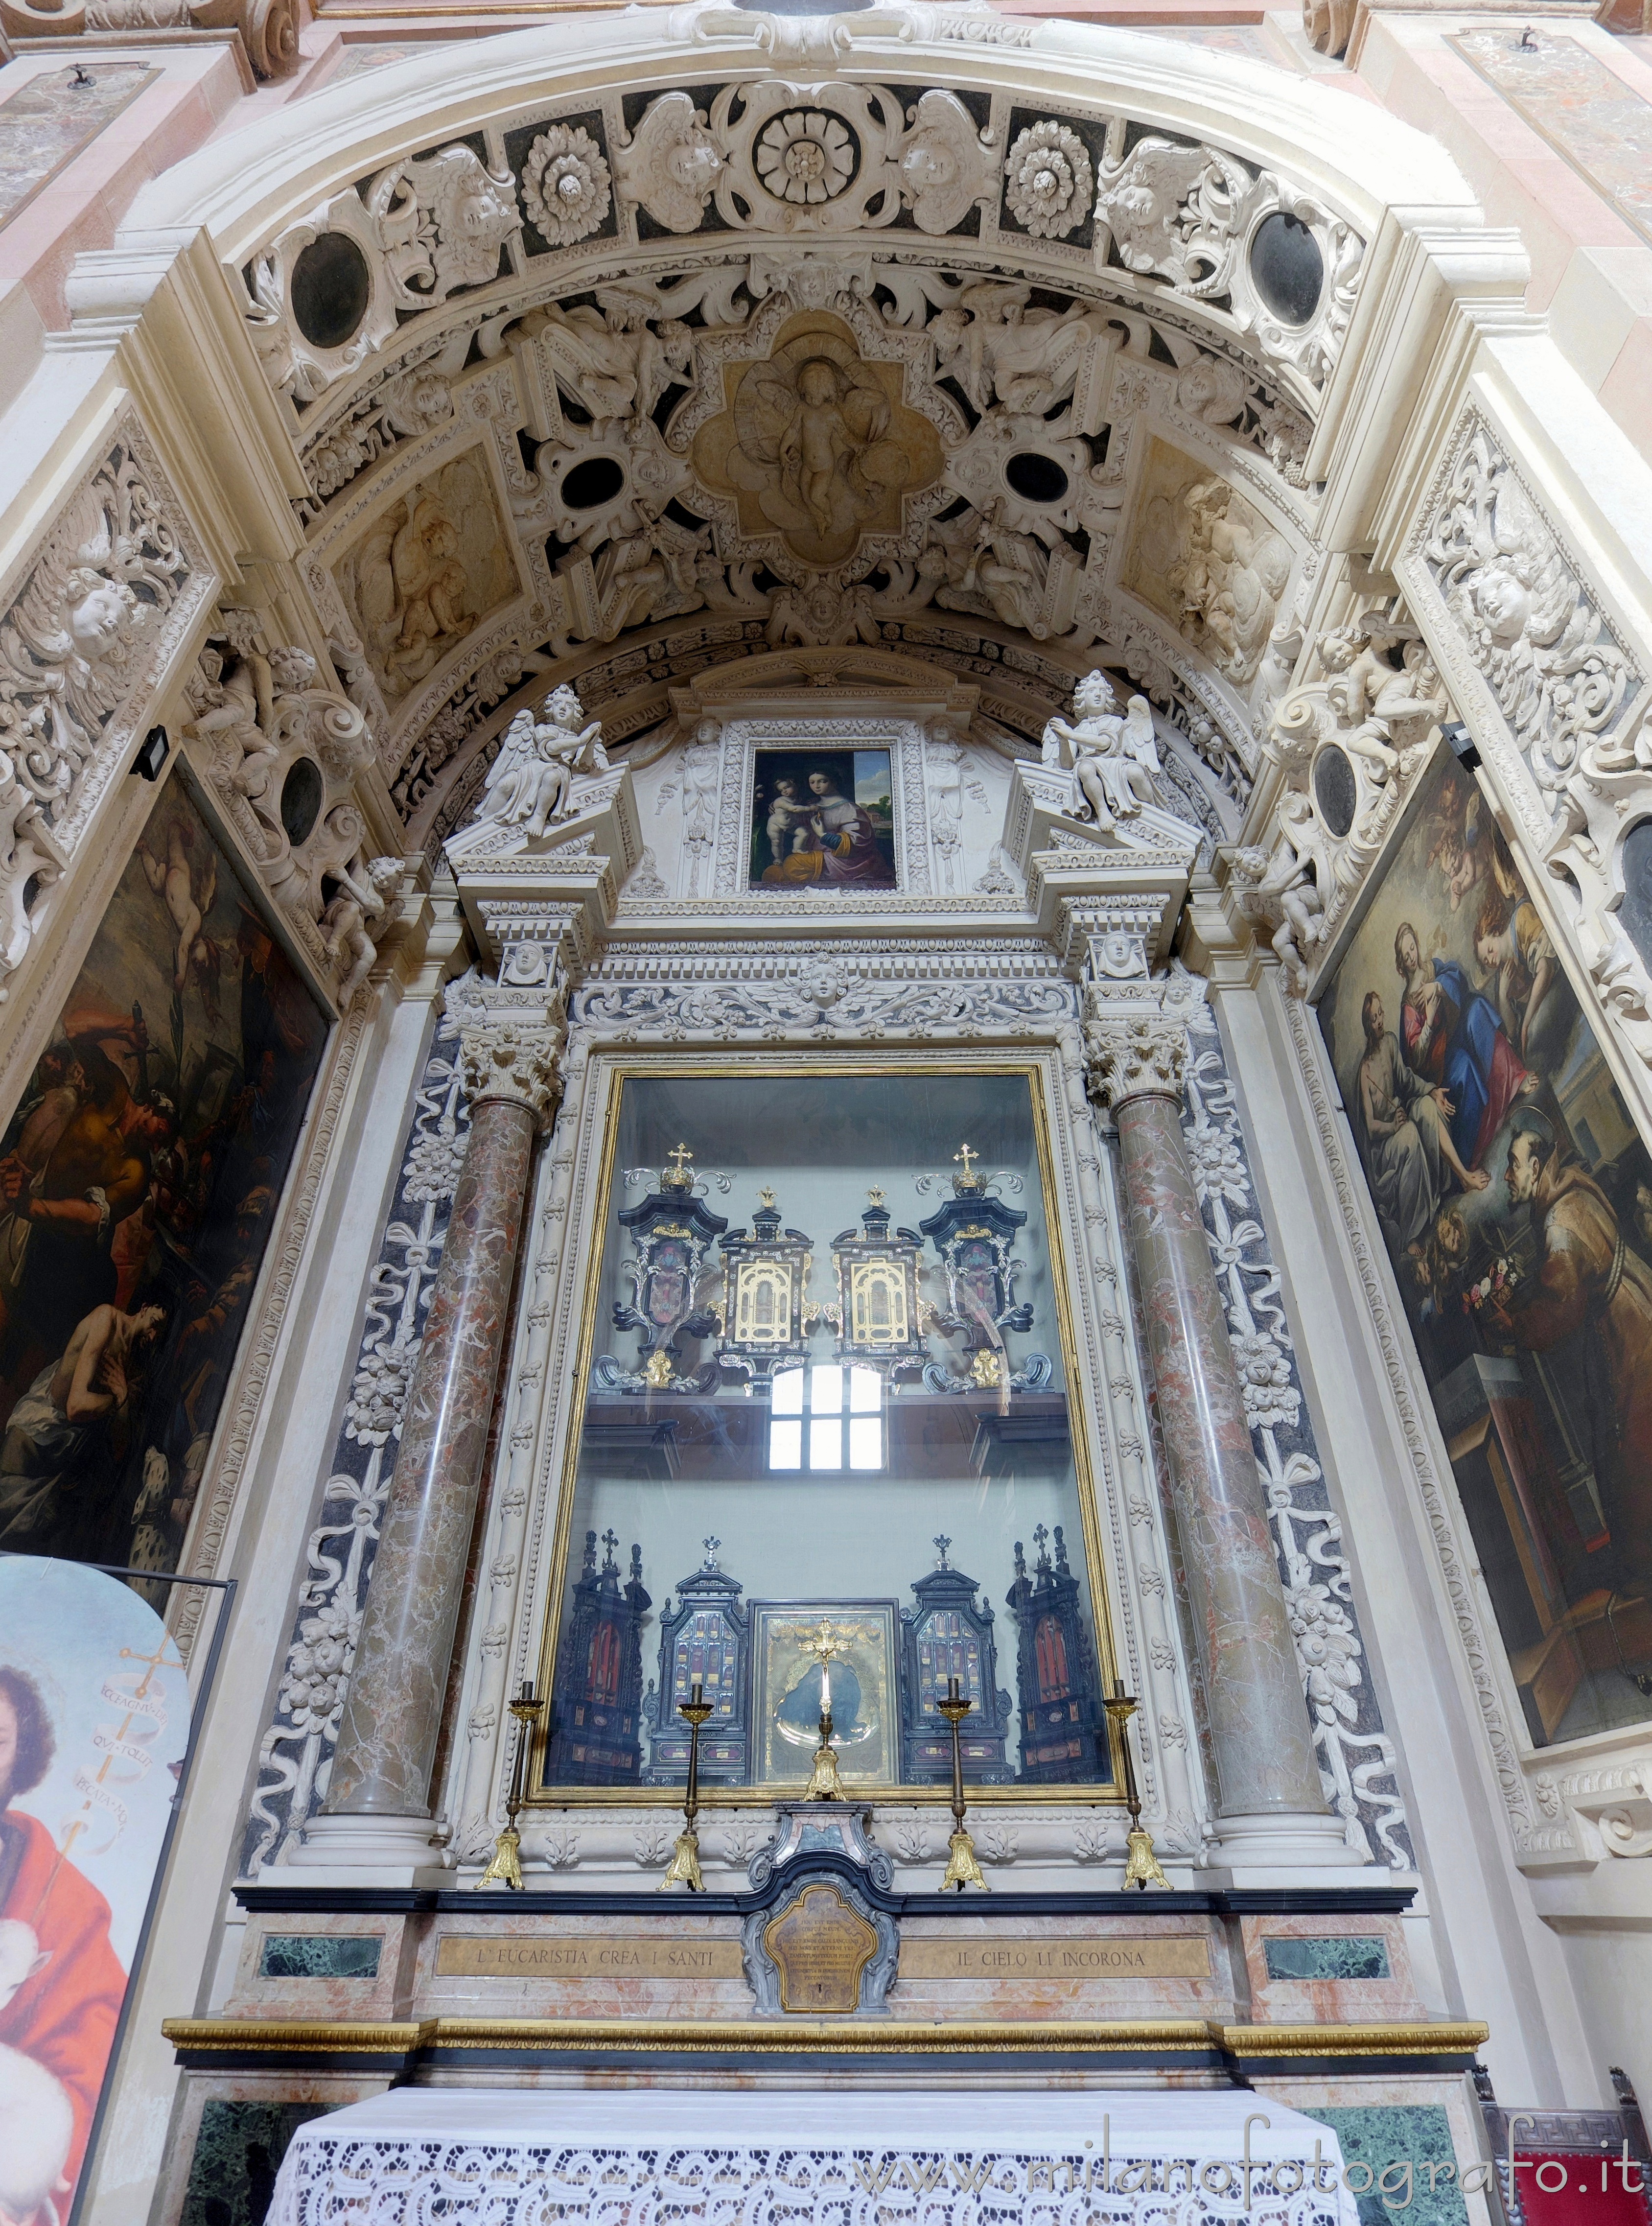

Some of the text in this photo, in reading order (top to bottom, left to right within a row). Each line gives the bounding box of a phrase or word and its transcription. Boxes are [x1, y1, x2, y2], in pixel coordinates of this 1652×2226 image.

[76, 1777, 111, 1806] PECATA
[498, 1949, 587, 1964] EUCARISTIA
[600, 1950, 640, 1964] CREA
[652, 1951, 656, 1965] I
[668, 1951, 713, 1966] SANTI
[958, 1952, 1145, 1967] IL CIELO LI INCORONA
